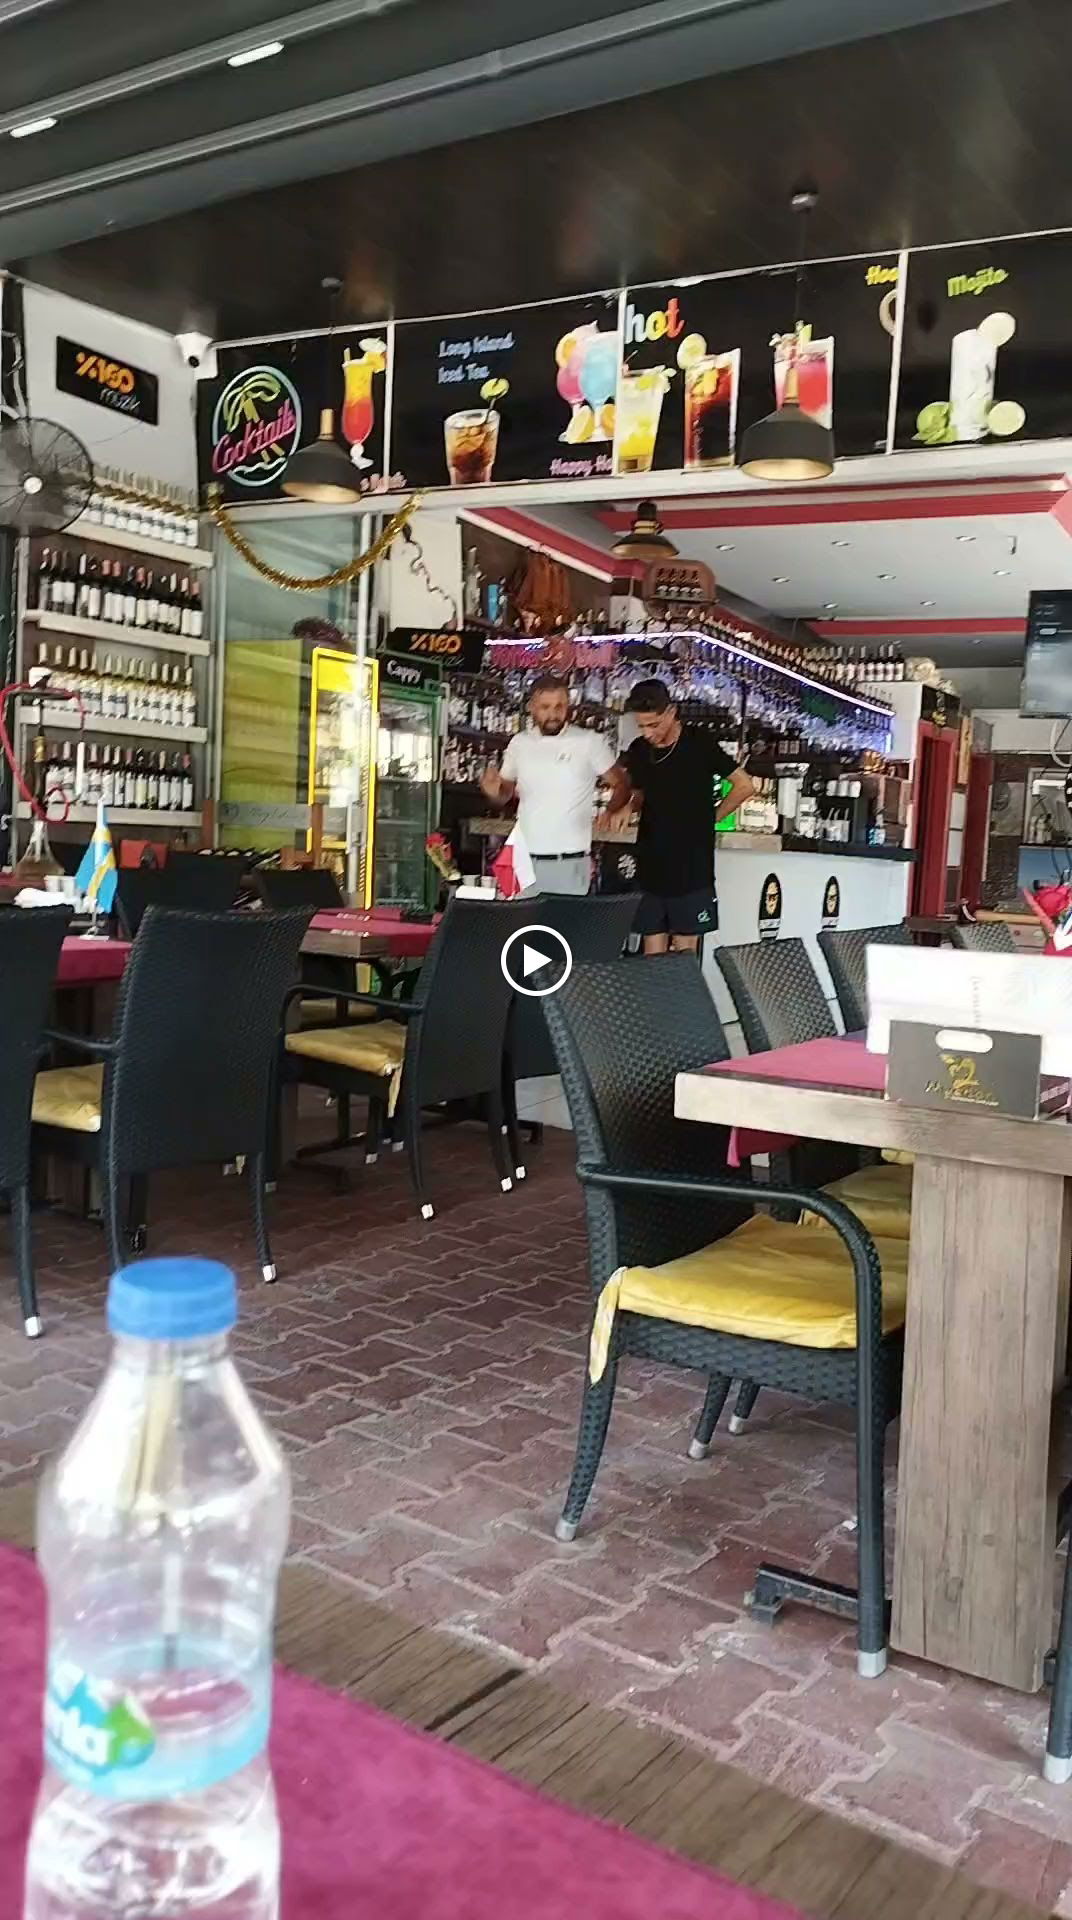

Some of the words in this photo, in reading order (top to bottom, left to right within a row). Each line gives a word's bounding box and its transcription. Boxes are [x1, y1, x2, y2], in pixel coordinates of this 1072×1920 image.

[947, 266, 1009, 297] Mojito
[625, 297, 685, 344] hot
[439, 340, 472, 360] Long
[473, 331, 516, 353] Island
[438, 364, 464, 384] Iced
[465, 362, 490, 380] Tea
[212, 397, 296, 473] Cocktails
[549, 458, 593, 477] Happy
[386, 659, 423, 685] Cappy
